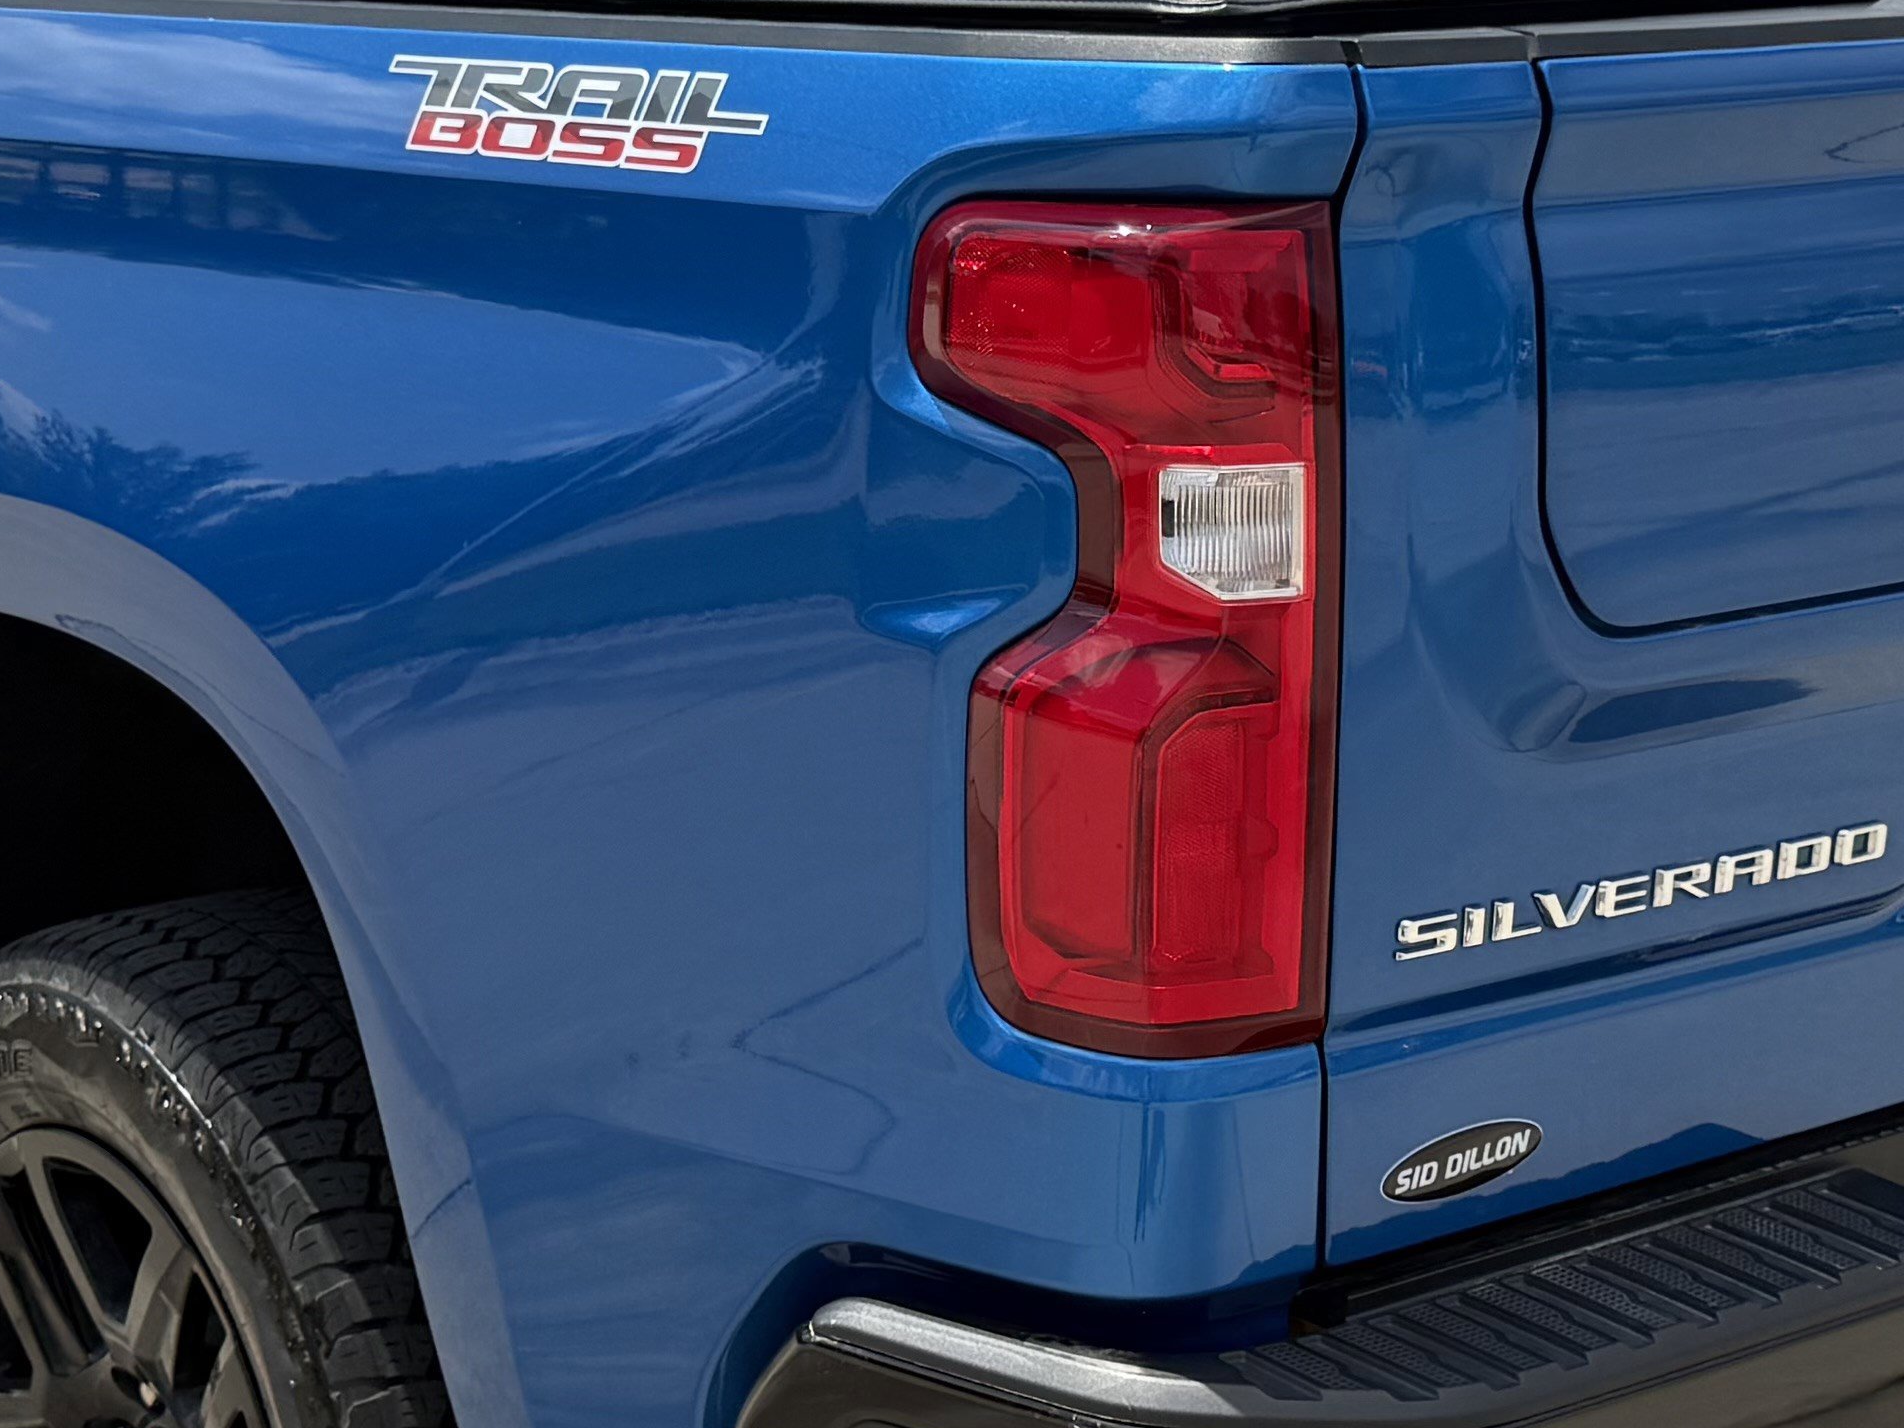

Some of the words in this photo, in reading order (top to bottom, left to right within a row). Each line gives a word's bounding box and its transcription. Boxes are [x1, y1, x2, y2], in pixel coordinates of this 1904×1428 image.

[388, 54, 770, 135] TRAIL
[405, 109, 710, 174] BOSS
[1394, 822, 1888, 962] SILVERADO
[1395, 1161, 1439, 1196] SID
[1445, 1129, 1532, 1180] DILLON
